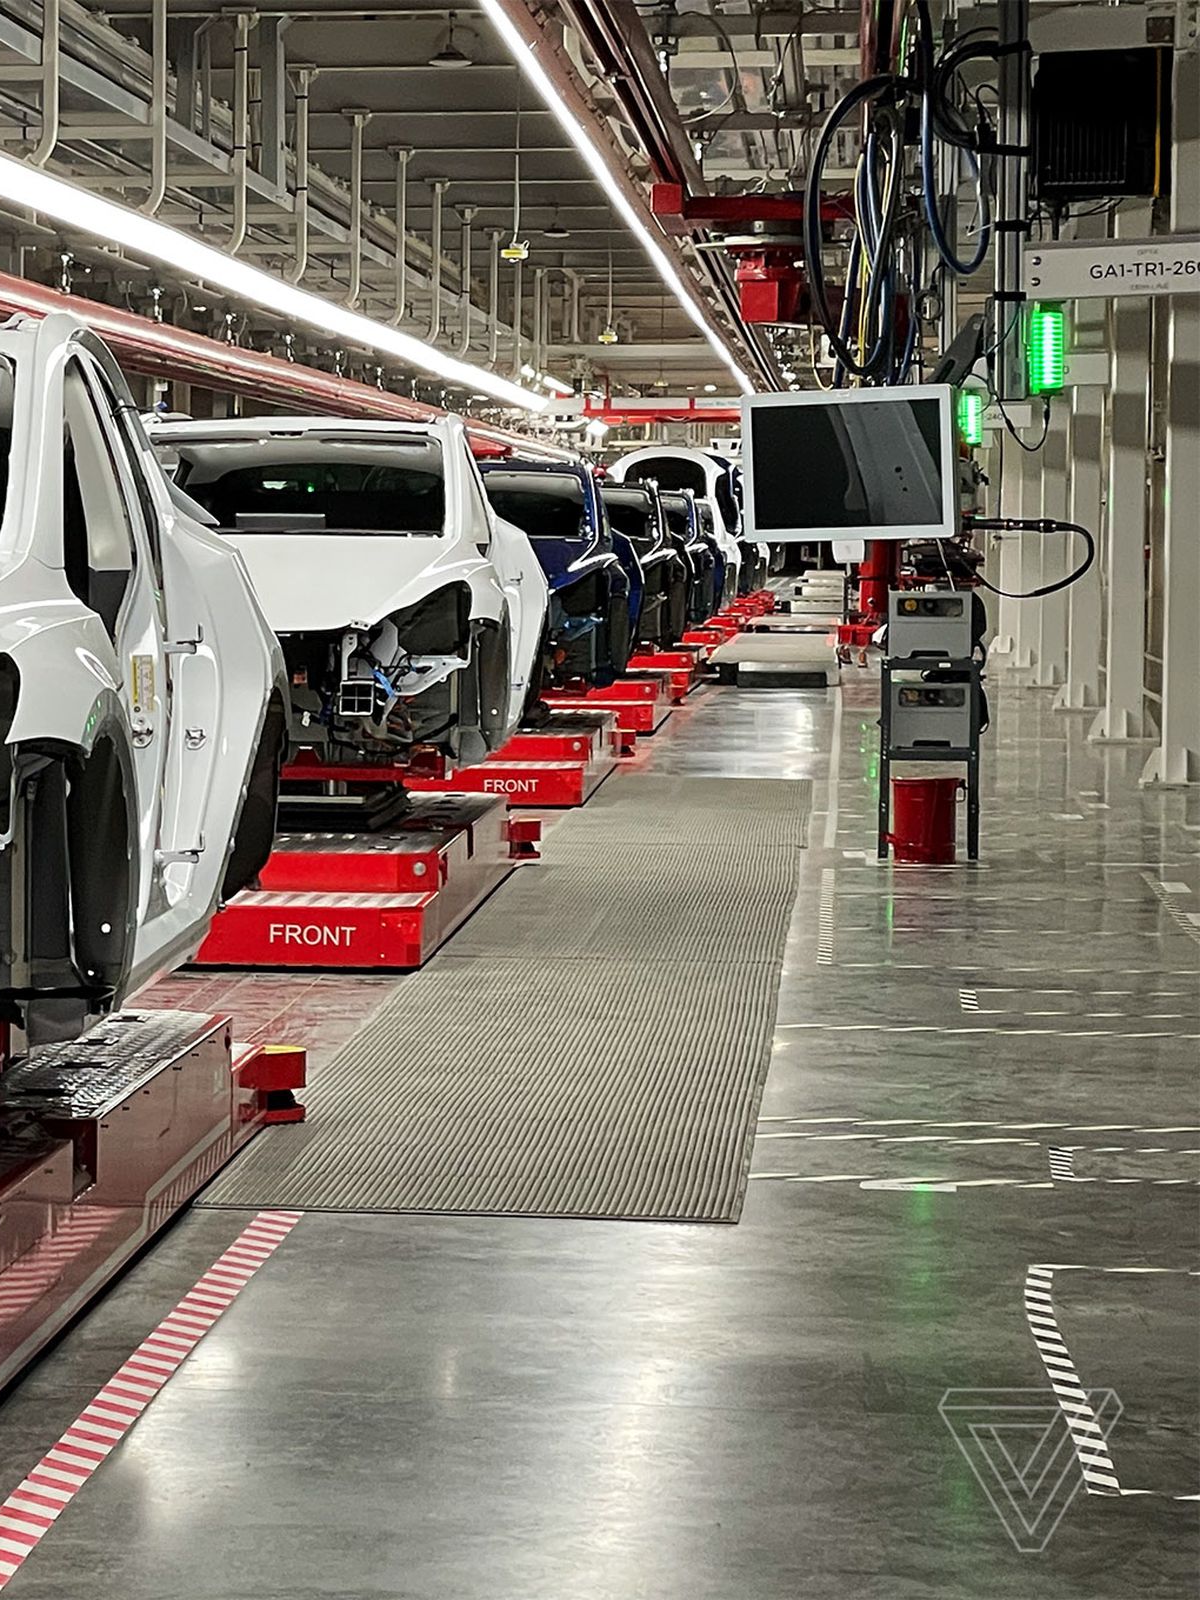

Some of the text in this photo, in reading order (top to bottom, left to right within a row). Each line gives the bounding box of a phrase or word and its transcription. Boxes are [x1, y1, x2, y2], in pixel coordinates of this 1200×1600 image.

[1089, 260, 1200, 279] GA1-TR1-26
[484, 779, 539, 793] FRONT
[269, 923, 357, 947] FRONT
